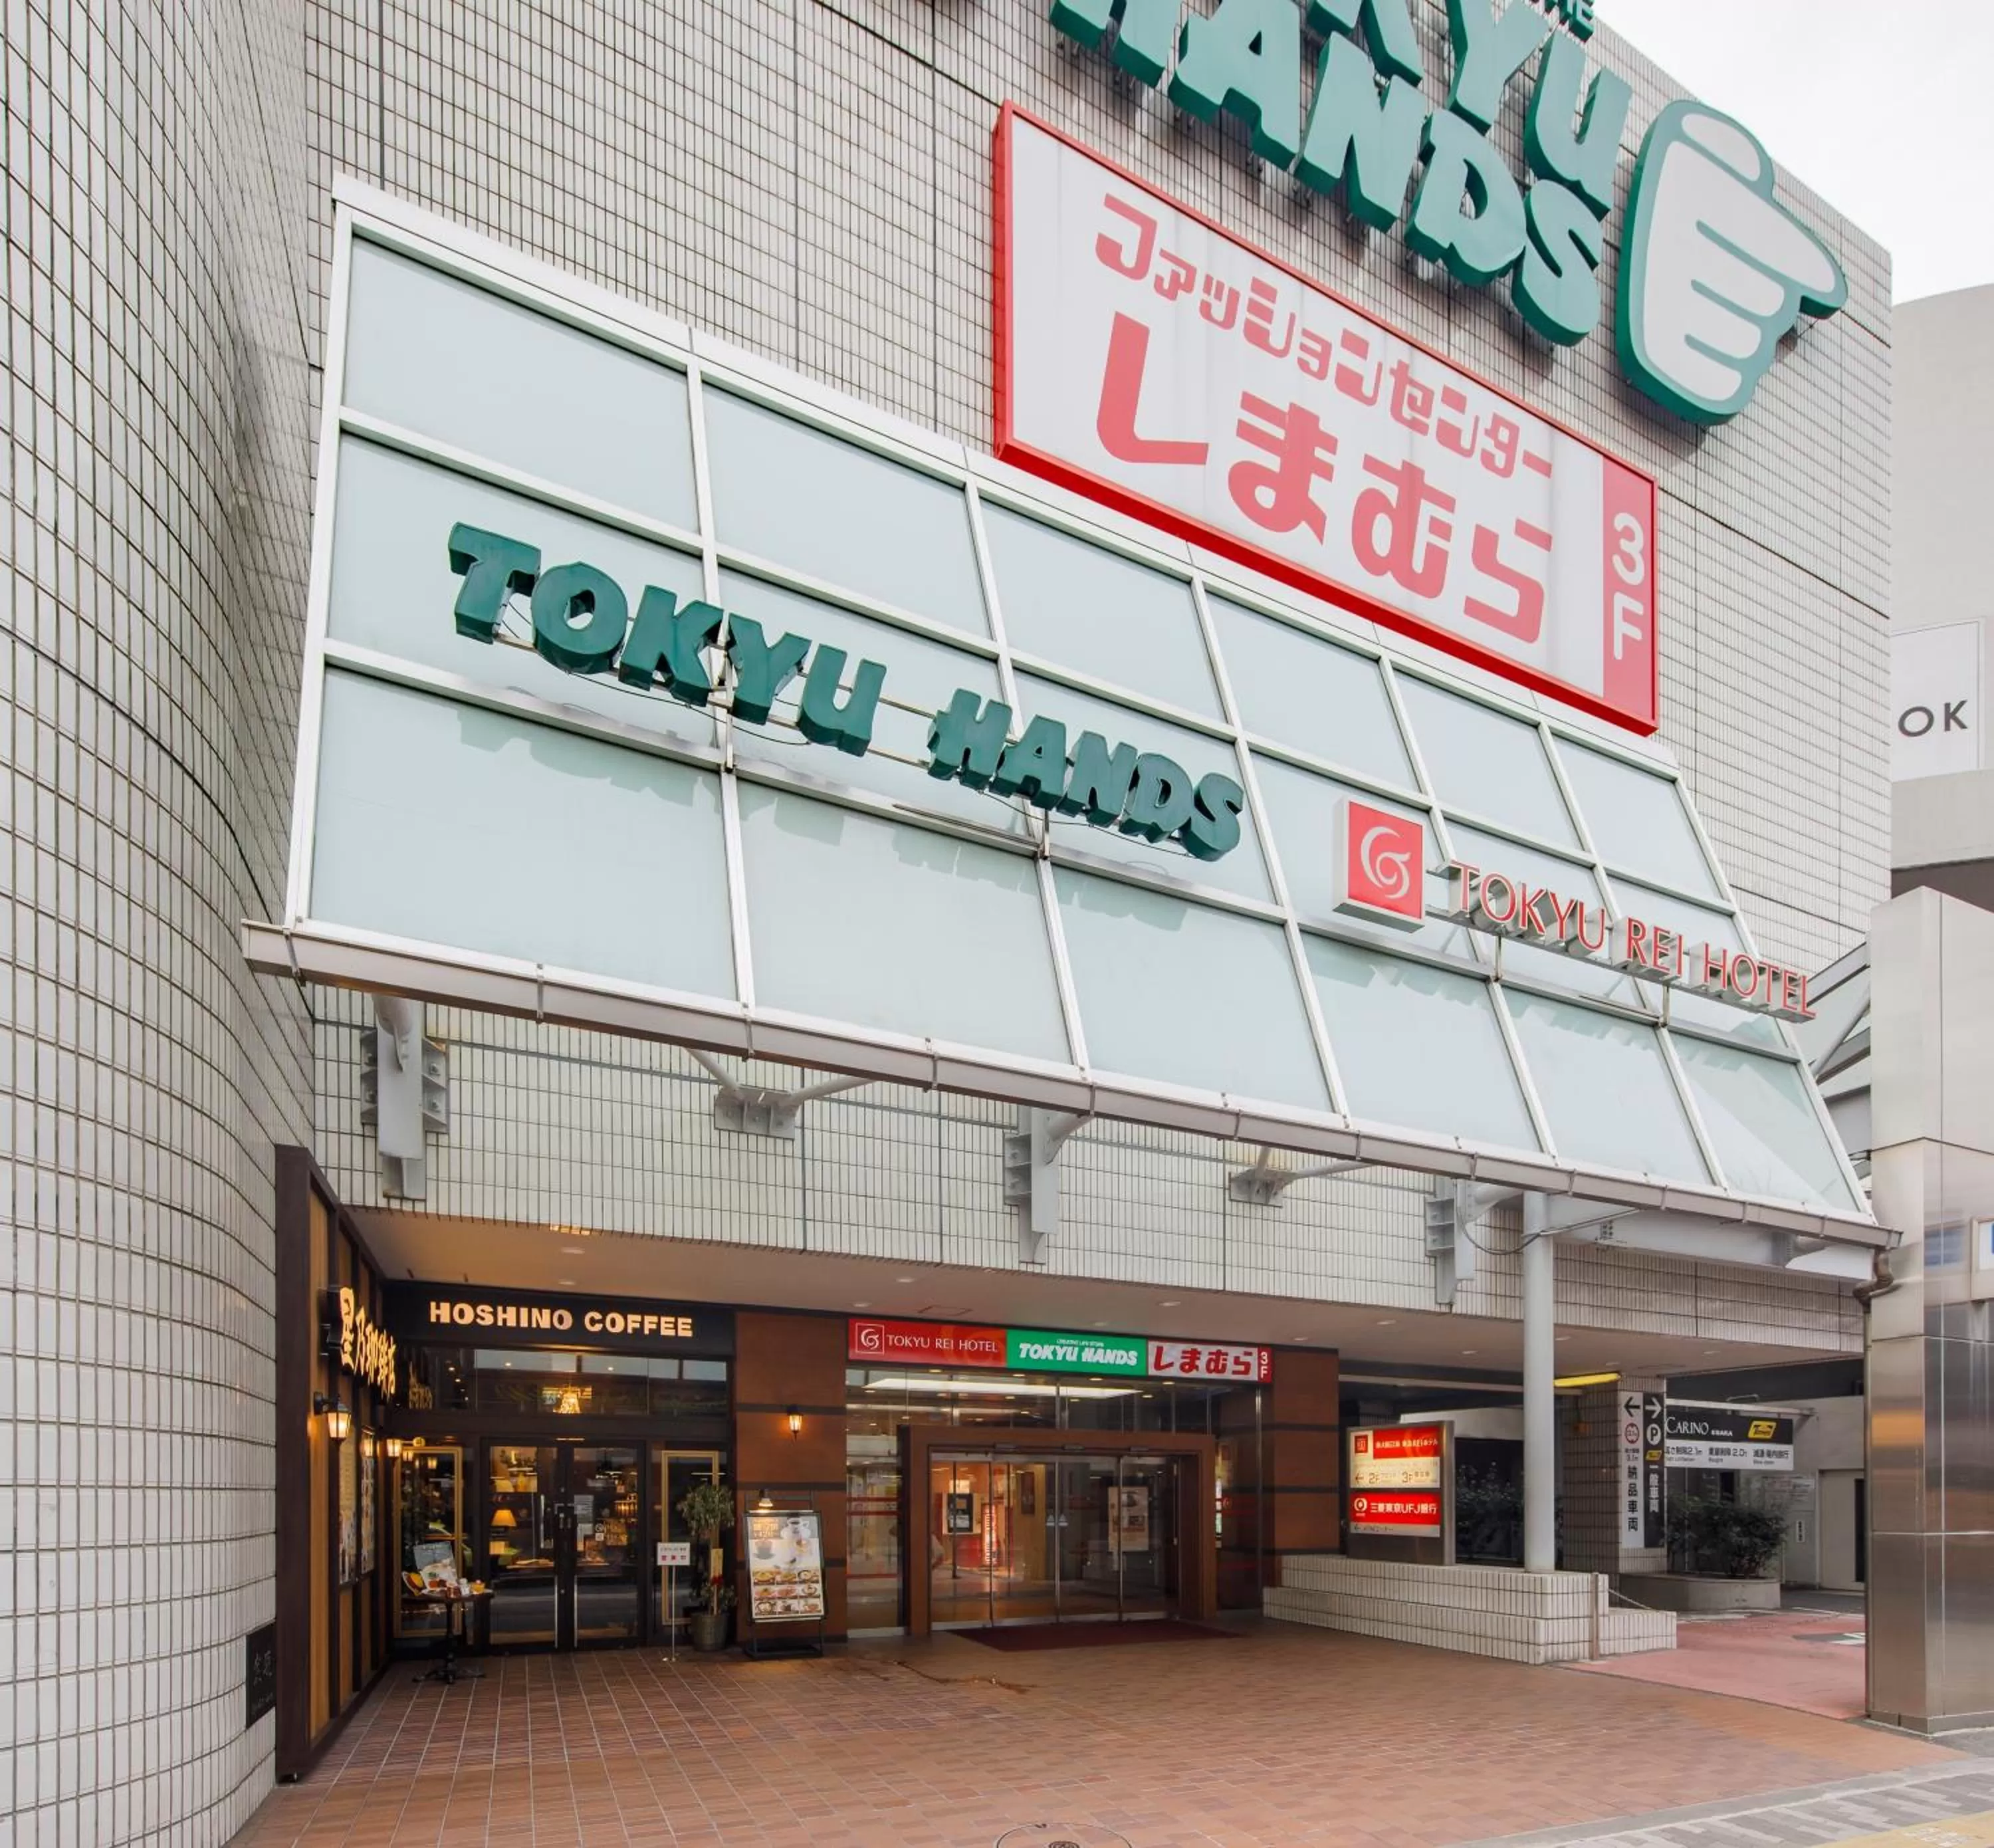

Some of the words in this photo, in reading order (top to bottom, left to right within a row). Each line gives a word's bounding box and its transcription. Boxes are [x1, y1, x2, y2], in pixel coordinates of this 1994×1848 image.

[1095, 193, 1552, 478] ファッションセンター
[1097, 311, 1552, 644] しまむら
[1612, 513, 1644, 660] 3F
[448, 522, 887, 756] TOKYU
[927, 689, 1244, 862] HANDS
[1898, 699, 1967, 737] OK
[1450, 860, 1605, 951] TOKYU
[1626, 917, 1684, 977] REI
[1704, 943, 1817, 1018] HOTEL
[430, 1301, 573, 1329] HOSHINO
[584, 1312, 693, 1337] COFFEE
[887, 1334, 930, 1348] TOKYU
[935, 1338, 954, 1349] REI
[959, 1340, 998, 1352] HOTEL
[1019, 1343, 1079, 1361] TOKYU
[1081, 1347, 1138, 1366] HANDS
[1154, 1346, 1253, 1375] しまむら
[1260, 1351, 1268, 1379] 3F
[1650, 1427, 1658, 1441] P
[1666, 1417, 1709, 1435] CARINO
